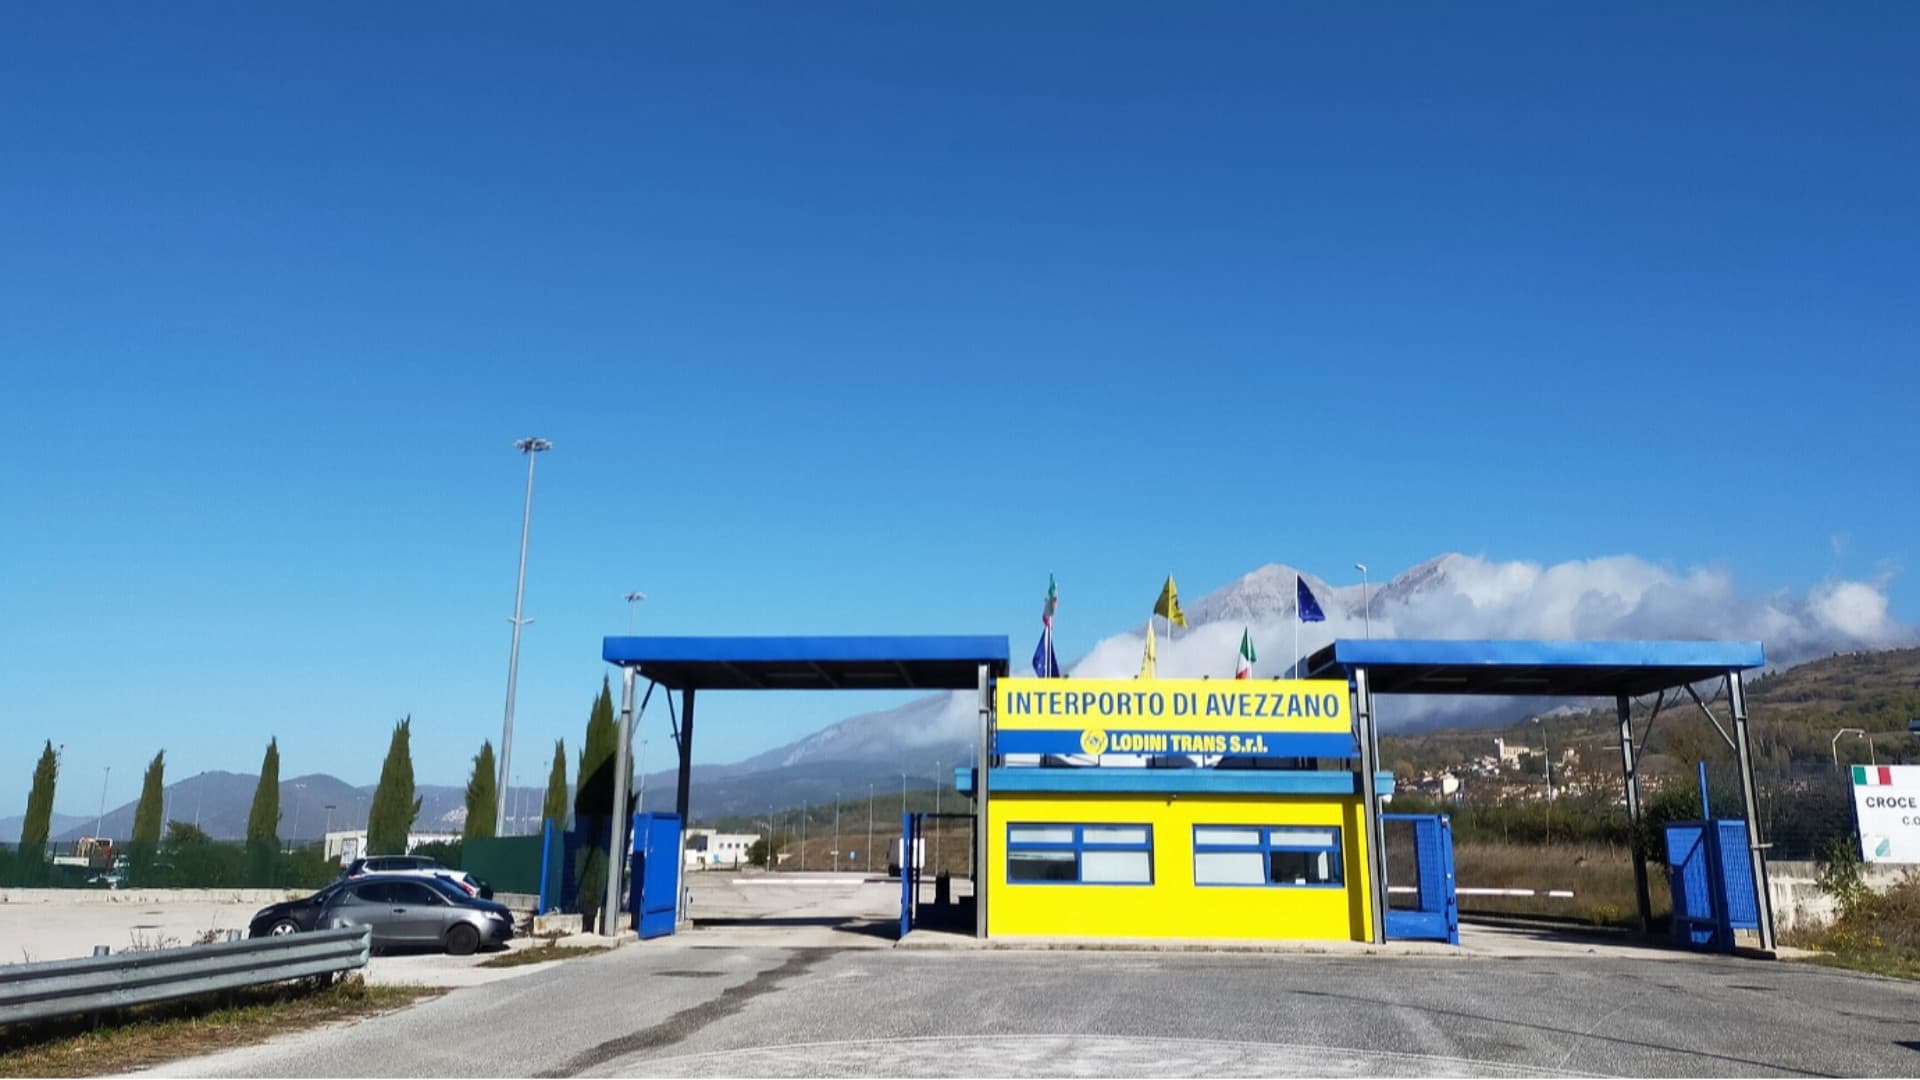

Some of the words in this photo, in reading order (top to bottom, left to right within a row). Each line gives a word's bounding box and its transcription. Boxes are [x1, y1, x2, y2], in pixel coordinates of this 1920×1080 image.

[1007, 691, 1165, 716] INTERPORTO
[1174, 693, 1198, 717] DI
[1205, 694, 1340, 718] AVEZZANO
[1111, 733, 1167, 752] LODINI
[1170, 735, 1228, 752] TRANS
[1866, 796, 1917, 808] CROCE
